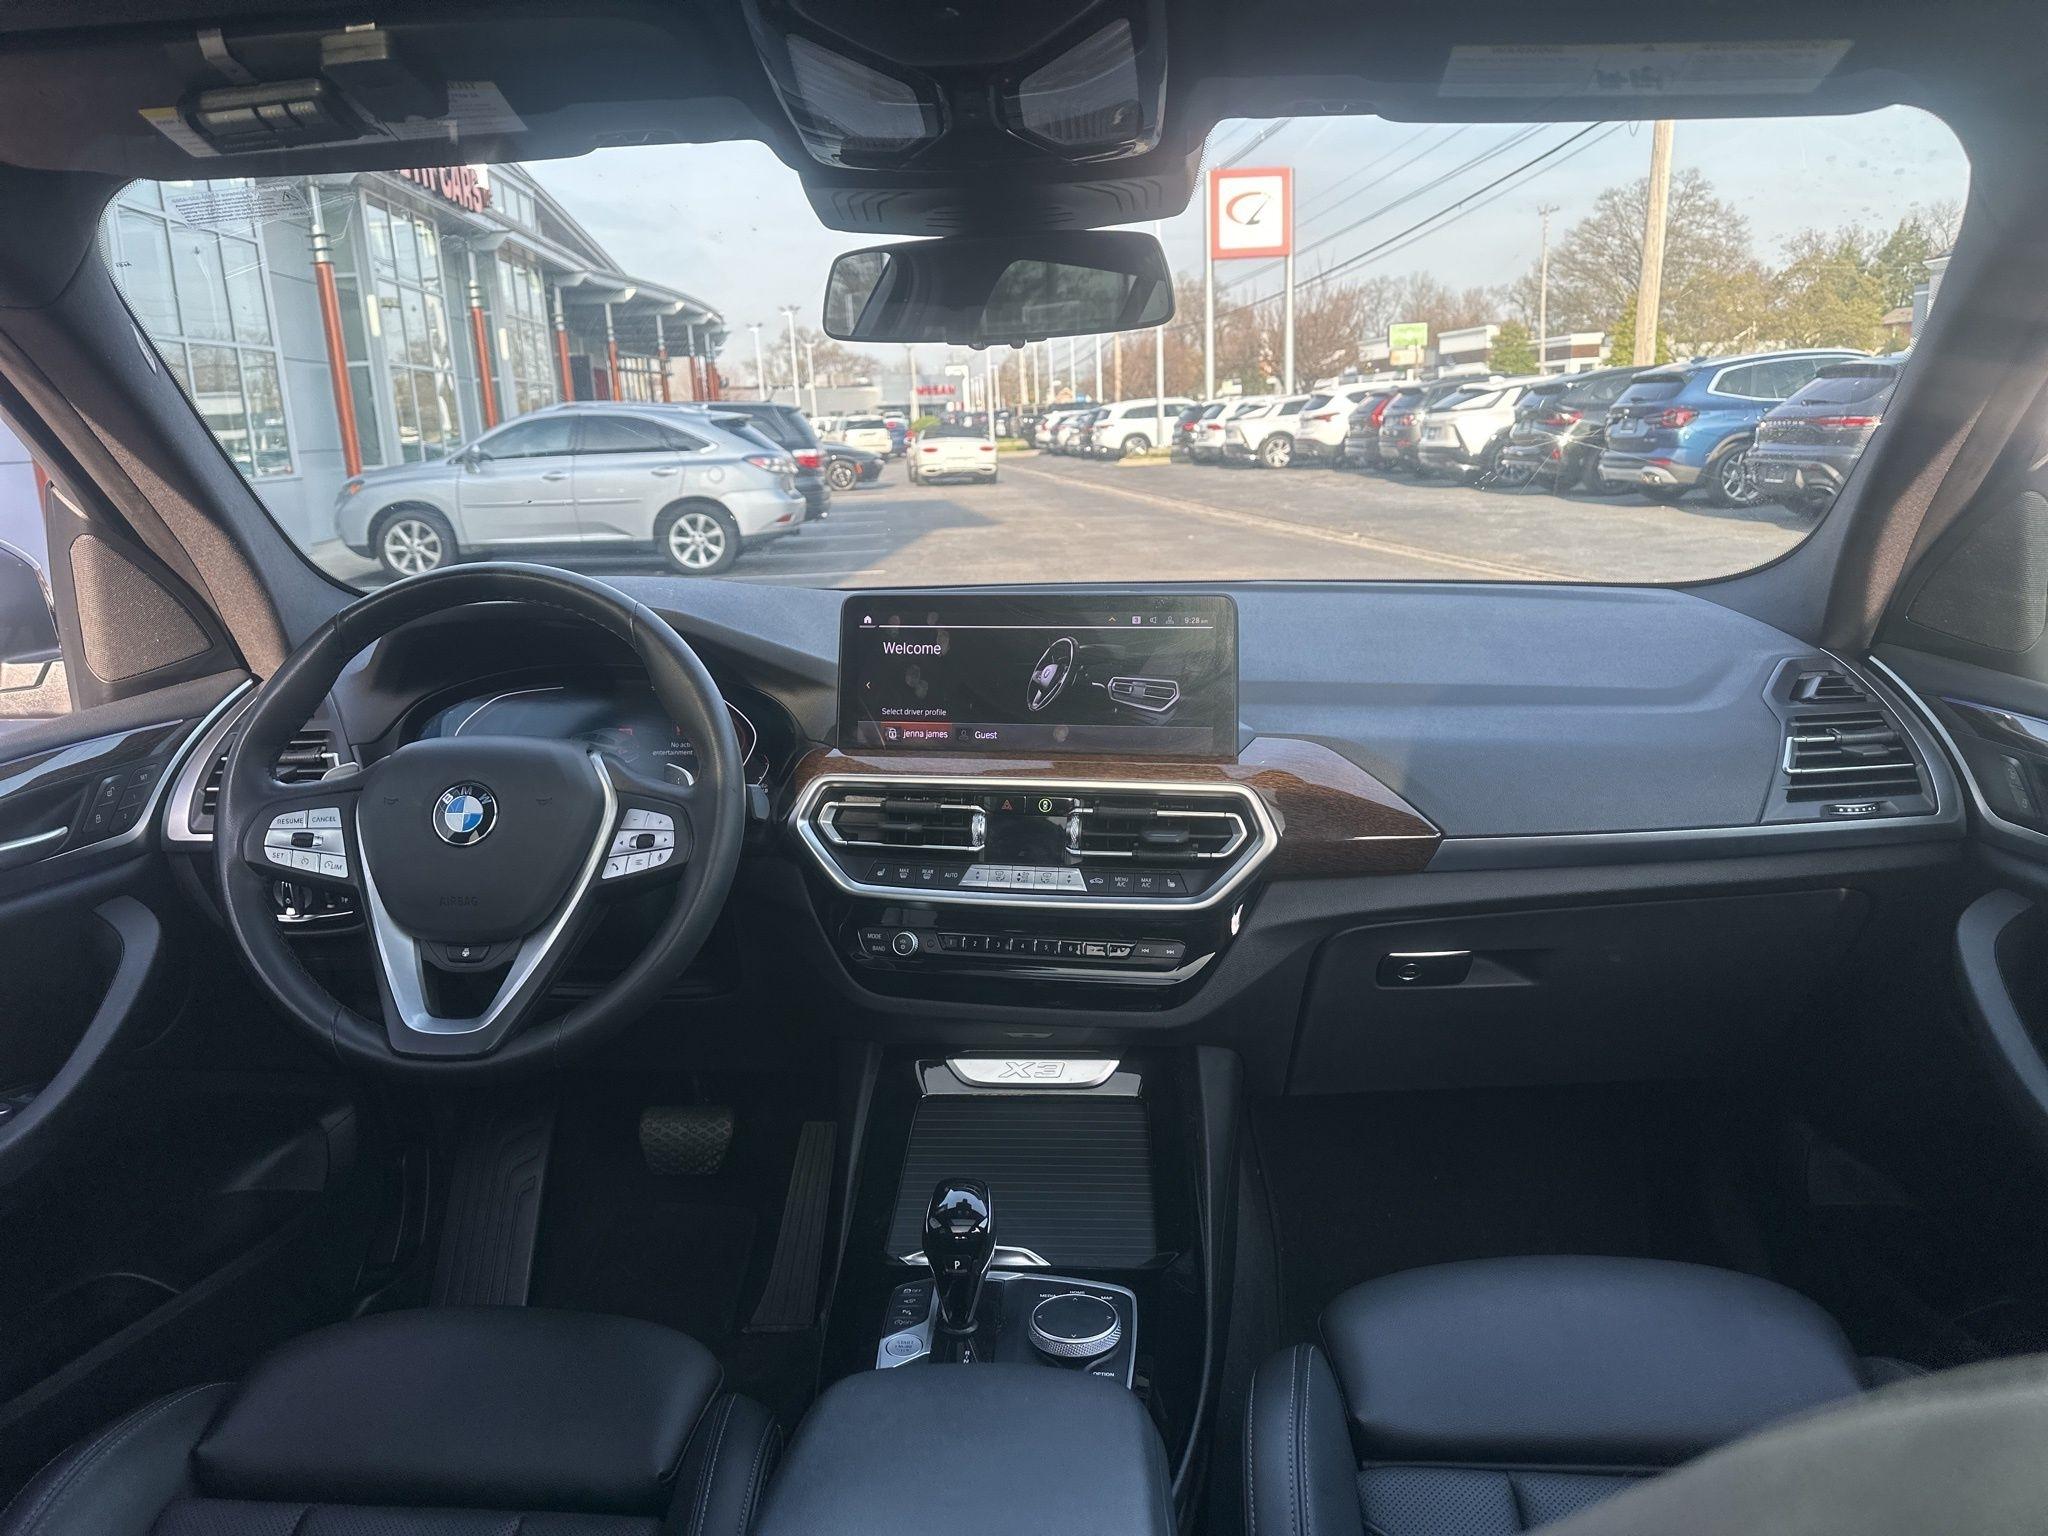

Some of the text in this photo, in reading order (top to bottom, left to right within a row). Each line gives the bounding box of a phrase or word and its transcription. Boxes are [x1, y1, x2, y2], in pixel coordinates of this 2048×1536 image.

[1184, 616, 1200, 625] 9:28
[883, 641, 942, 655] Welcome
[904, 708, 923, 716] driver
[925, 709, 947, 717] profile
[903, 730, 949, 739] jenna james
[974, 730, 998, 739] Guest
[277, 817, 304, 825] RESUME
[311, 816, 336, 824] CANCEL
[999, 1061, 1065, 1079] X3
[954, 1260, 961, 1270] P
